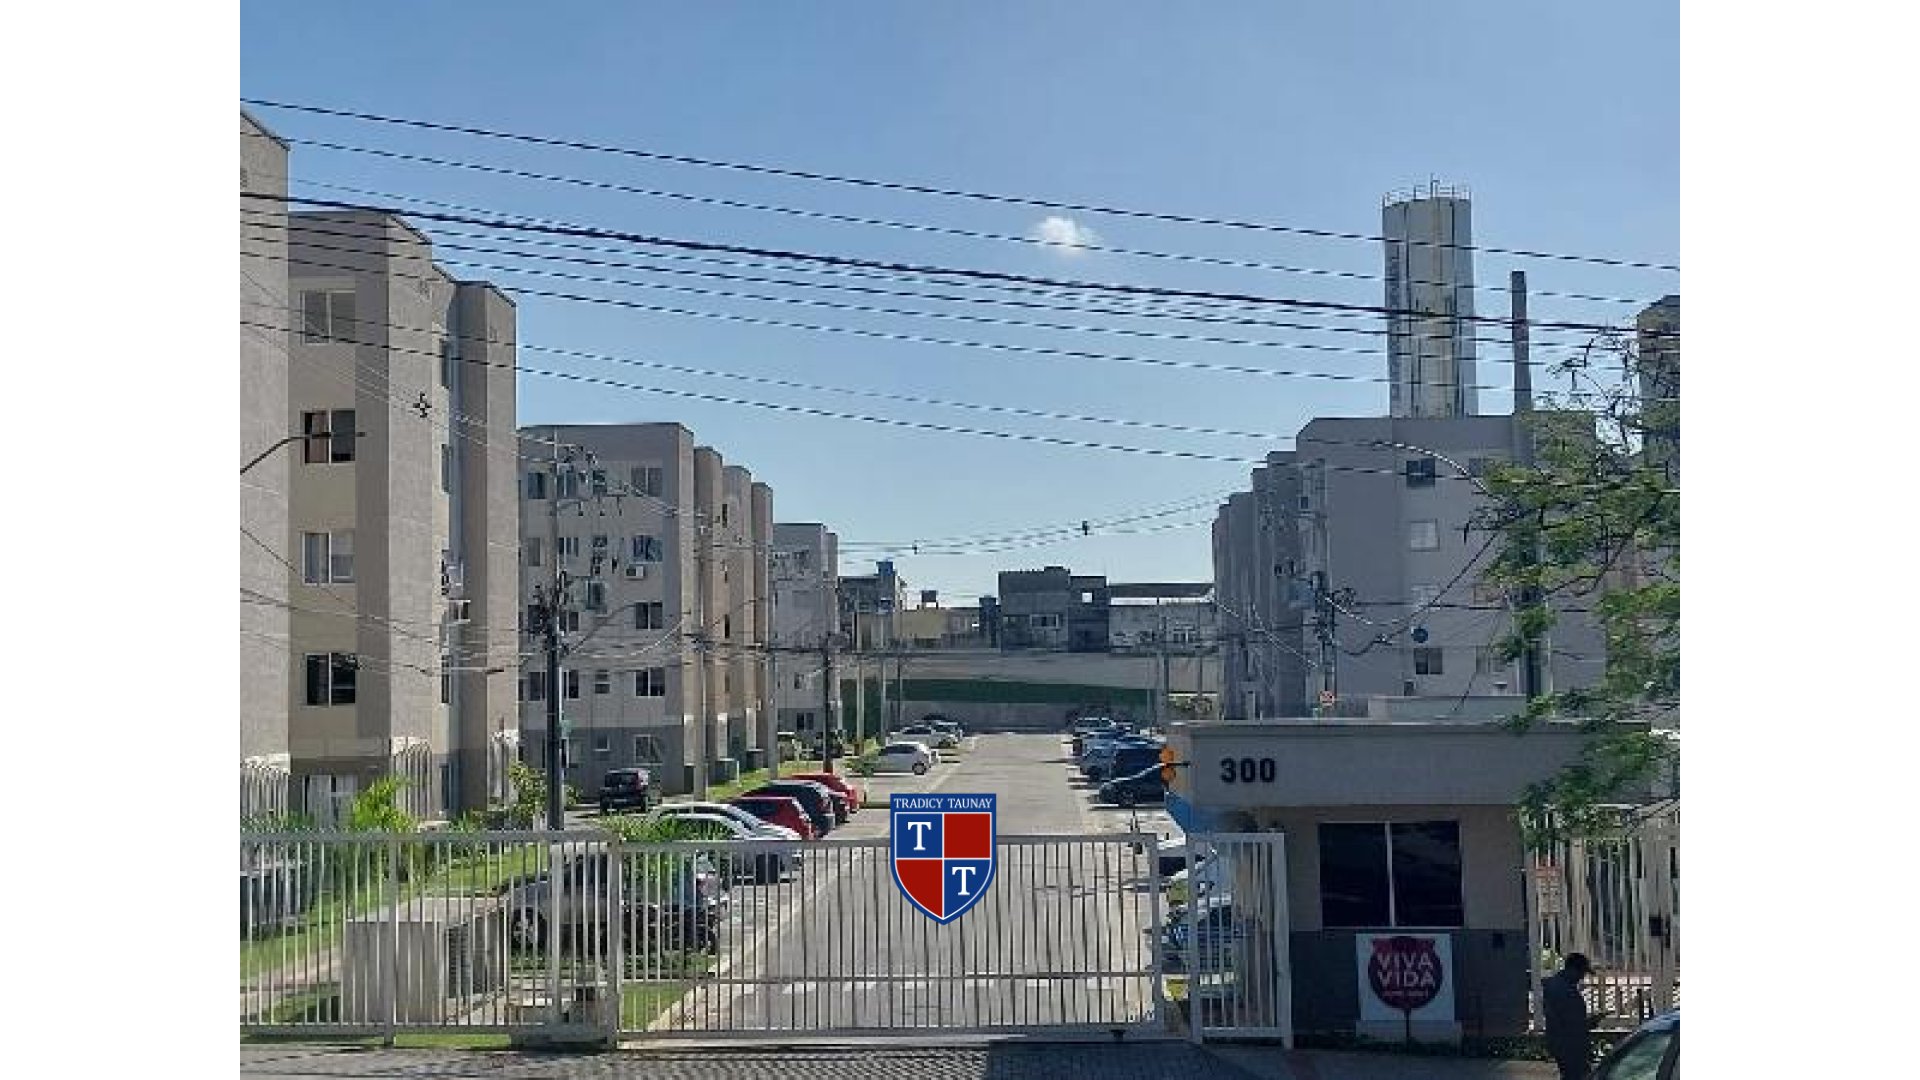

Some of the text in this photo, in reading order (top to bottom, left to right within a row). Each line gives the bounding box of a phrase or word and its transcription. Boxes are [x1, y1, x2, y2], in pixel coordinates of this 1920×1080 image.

[1220, 757, 1276, 784] 300
[1376, 952, 1434, 970] VIVA
[1376, 970, 1436, 988] VIDA
